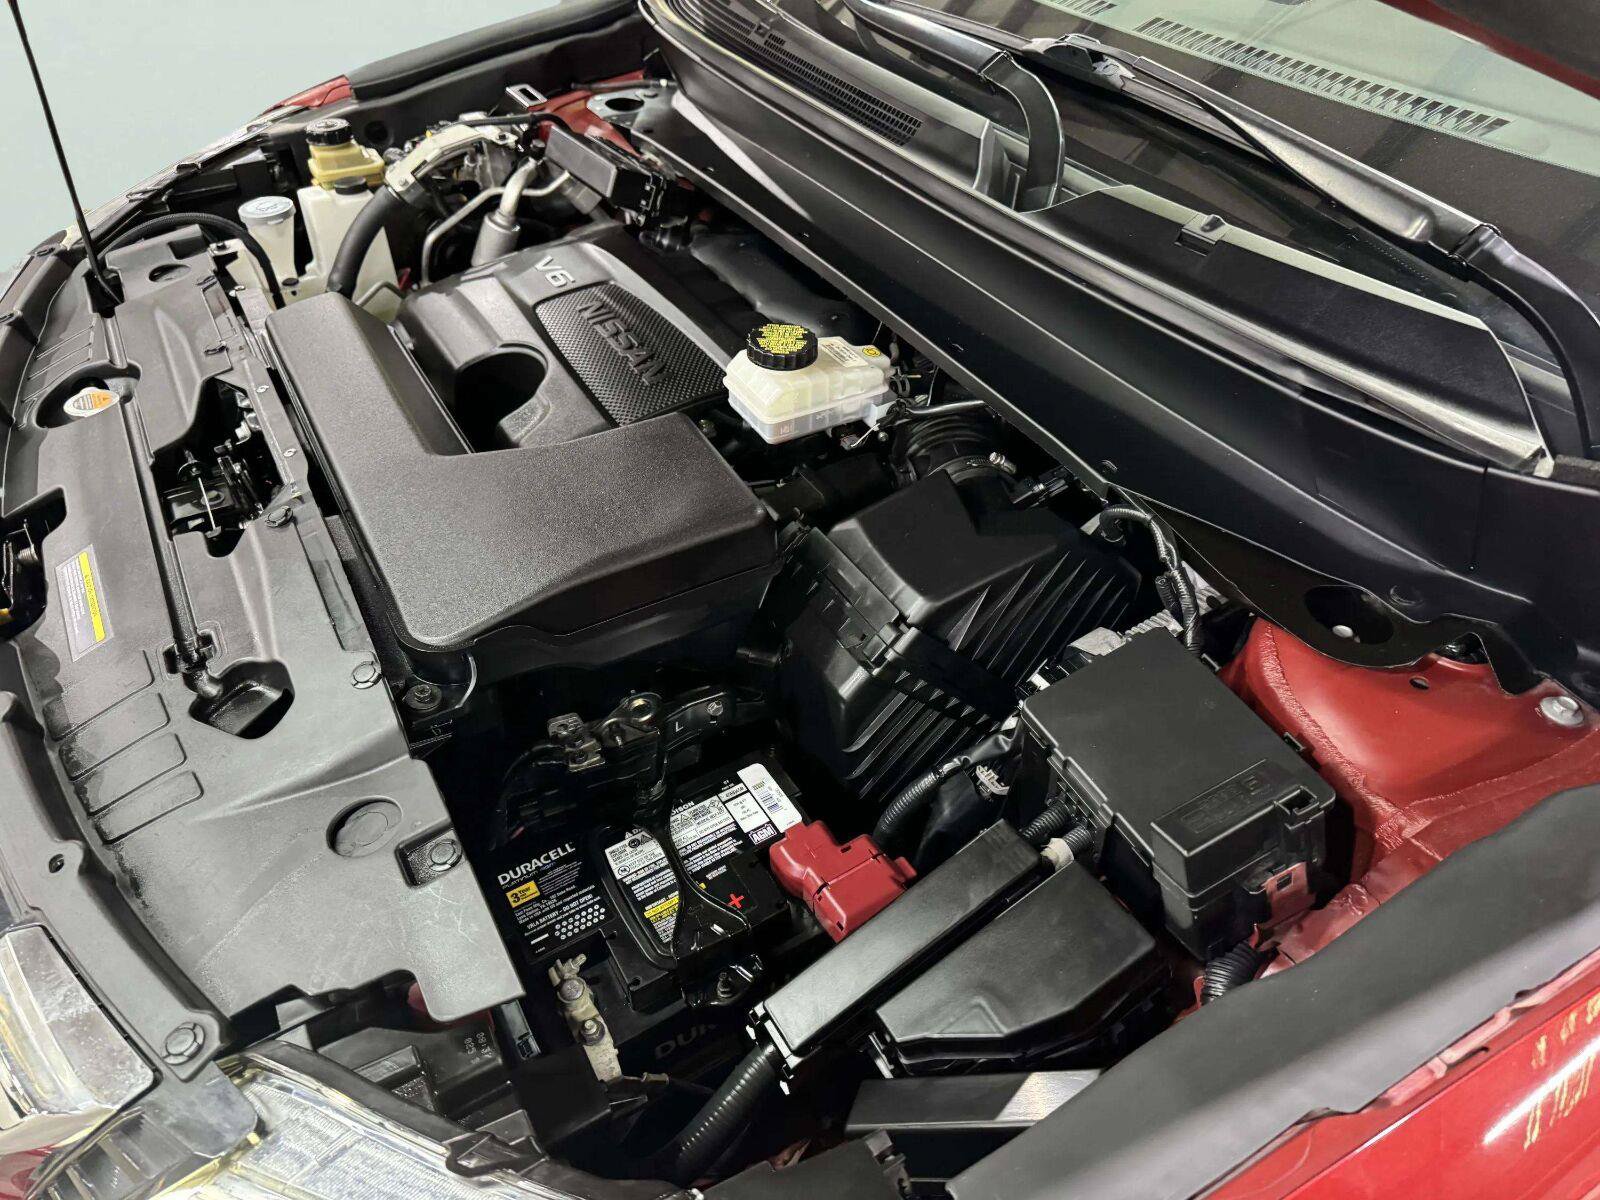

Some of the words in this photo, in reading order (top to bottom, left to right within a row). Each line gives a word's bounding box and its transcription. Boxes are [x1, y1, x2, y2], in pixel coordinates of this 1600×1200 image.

[534, 256, 576, 288] V6
[577, 299, 675, 387] NISSAN
[752, 826, 775, 844] AGM
[498, 842, 576, 886] DURACELL
[510, 892, 521, 904] 3
[539, 911, 560, 923] BATTERY
